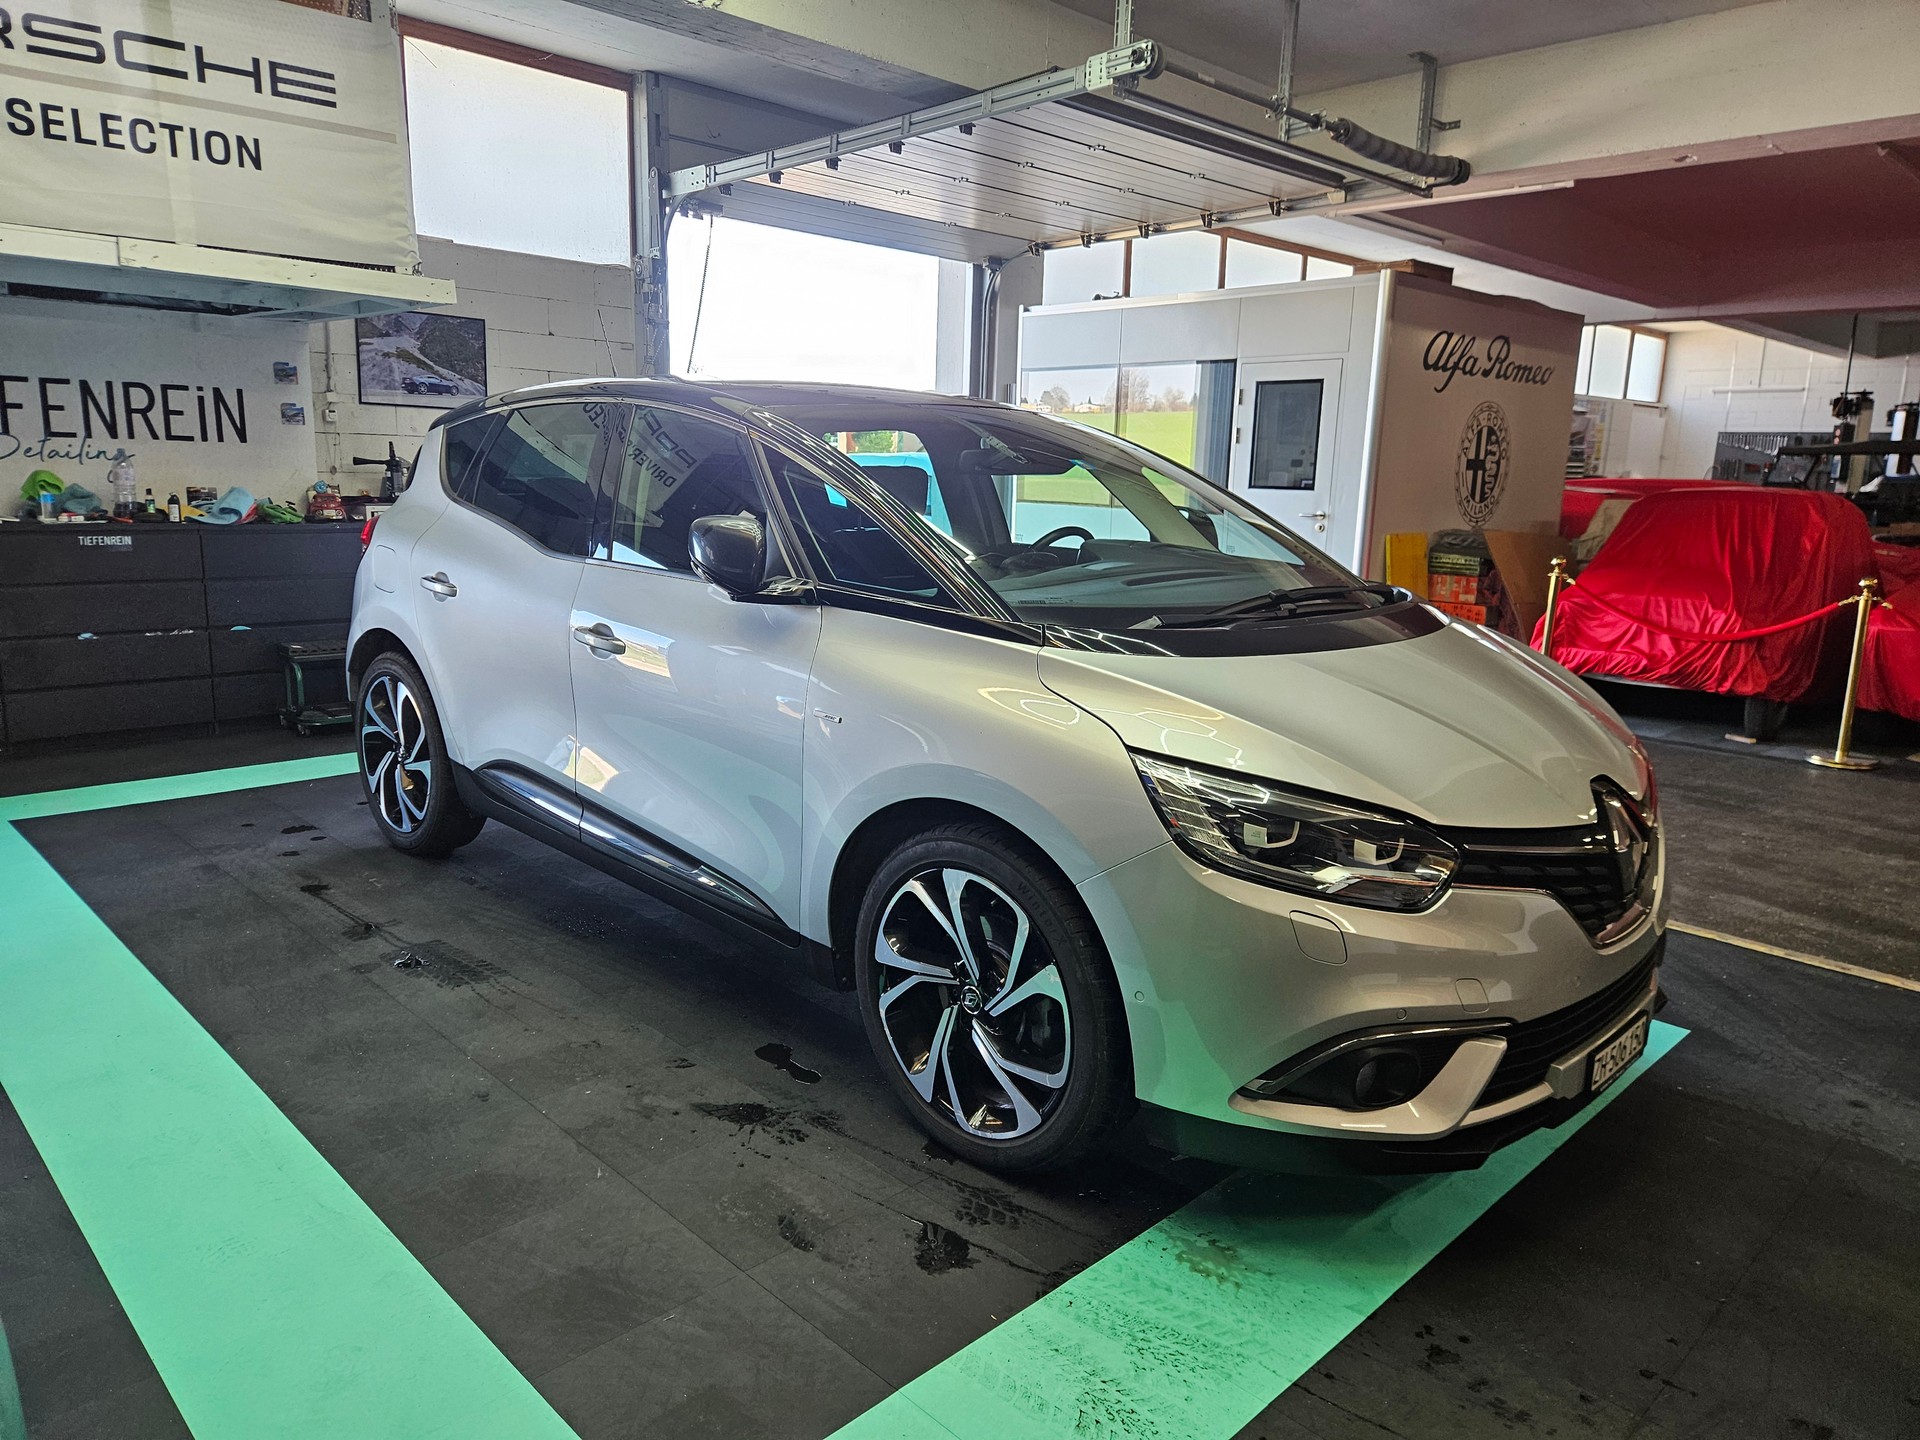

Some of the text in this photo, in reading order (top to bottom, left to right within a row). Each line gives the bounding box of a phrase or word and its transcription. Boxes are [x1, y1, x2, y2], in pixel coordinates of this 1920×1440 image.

[0, 8, 338, 109] SCHE
[5, 97, 263, 171] SELECTION
[1422, 330, 1556, 393] Alfa Romeo
[1463, 495, 1496, 516] MILANO
